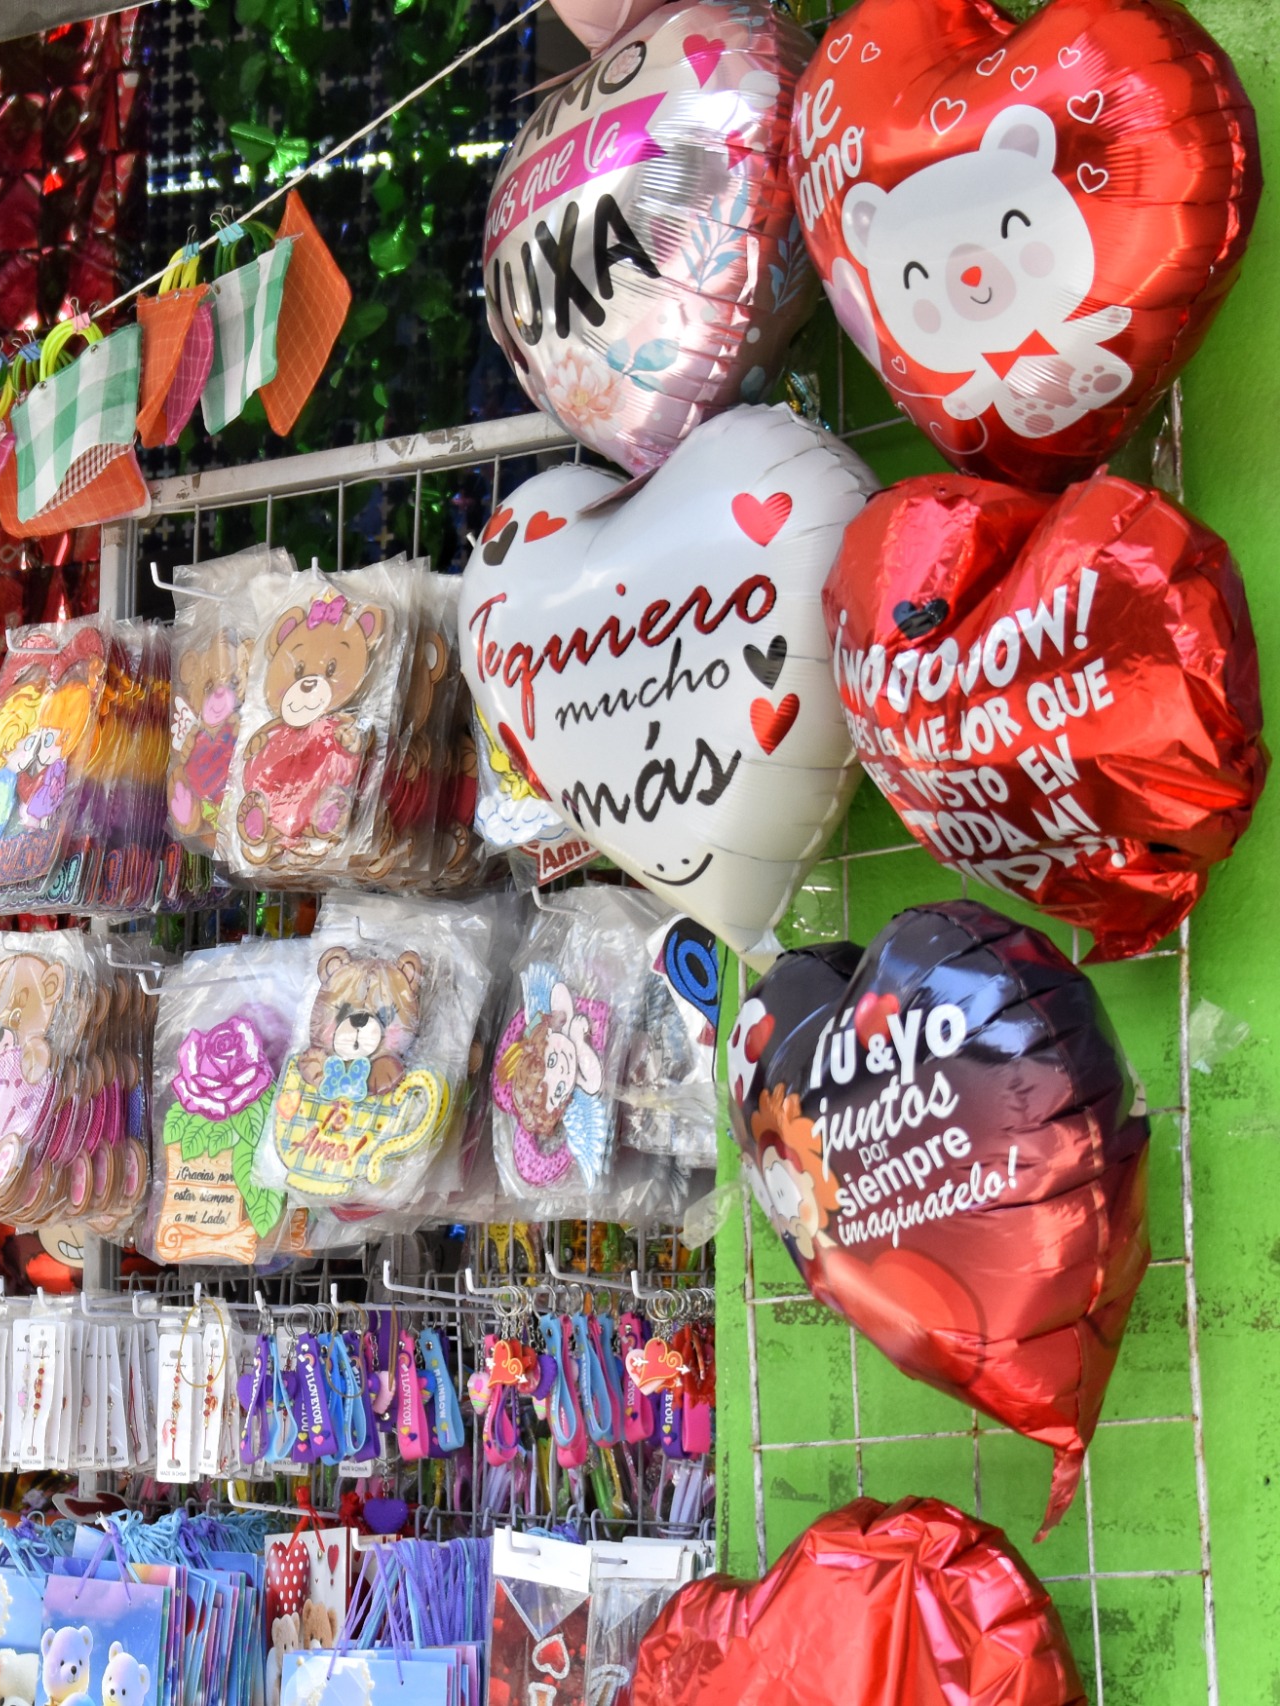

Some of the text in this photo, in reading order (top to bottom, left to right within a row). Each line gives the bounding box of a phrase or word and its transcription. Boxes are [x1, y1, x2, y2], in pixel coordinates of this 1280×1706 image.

[521, 138, 576, 215] que
[583, 104, 620, 174] la
[797, 78, 842, 159] te
[799, 126, 865, 232] amo
[555, 637, 730, 731] mucho
[904, 696, 1022, 764] MEJOR
[1026, 658, 1115, 731] QUE
[561, 720, 742, 832] más
[901, 766, 1009, 808] VISTO
[1017, 733, 1080, 795] EN
[902, 793, 1101, 858] TODA MI
[811, 1070, 960, 1183] juntos
[835, 1126, 972, 1218] siempre
[857, 1139, 891, 1172] por
[173, 1187, 235, 1206] estar siempre
[185, 1211, 198, 1223] mi
[837, 1145, 1019, 1249] imaginatelo!
